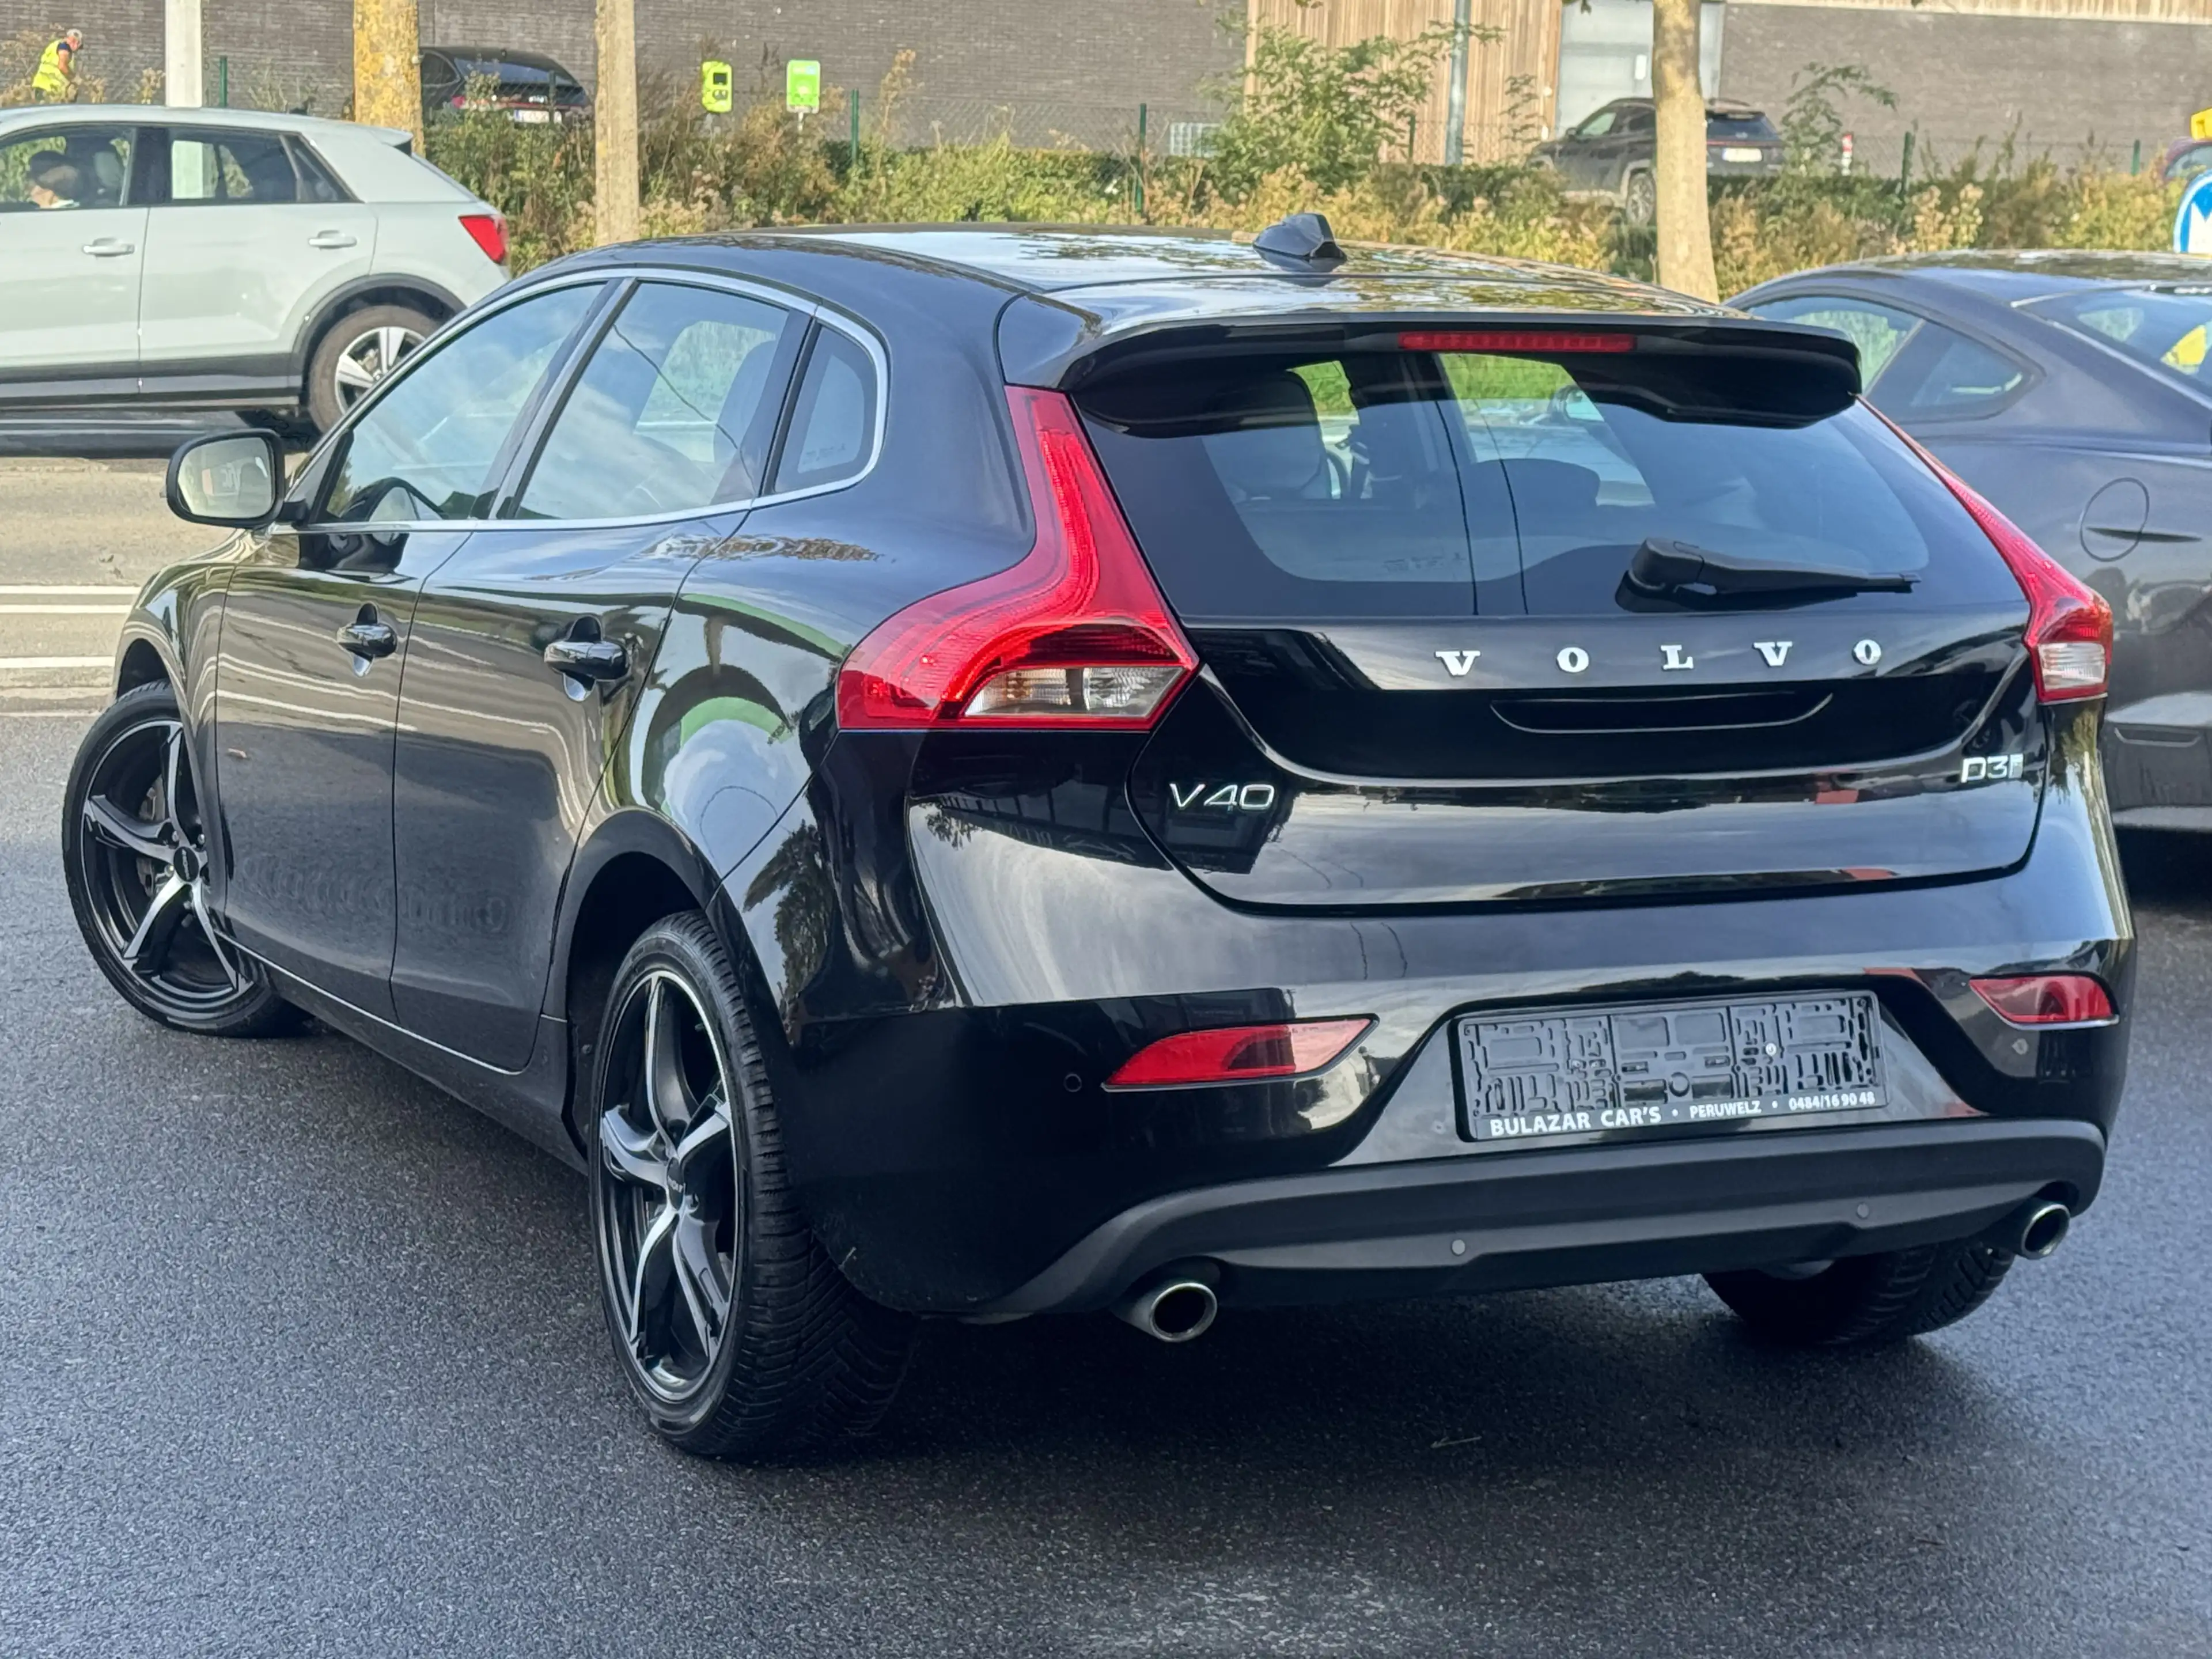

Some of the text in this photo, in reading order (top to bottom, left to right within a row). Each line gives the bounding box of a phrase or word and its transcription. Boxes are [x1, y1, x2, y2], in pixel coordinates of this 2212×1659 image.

[1435, 639, 1882, 677] VOLVO
[1169, 783, 1275, 812] V40
[1490, 1112, 1592, 1137] BULAZAR
[1600, 1106, 1662, 1127] CAR'S
[1689, 1100, 1762, 1119] PERUWELZ
